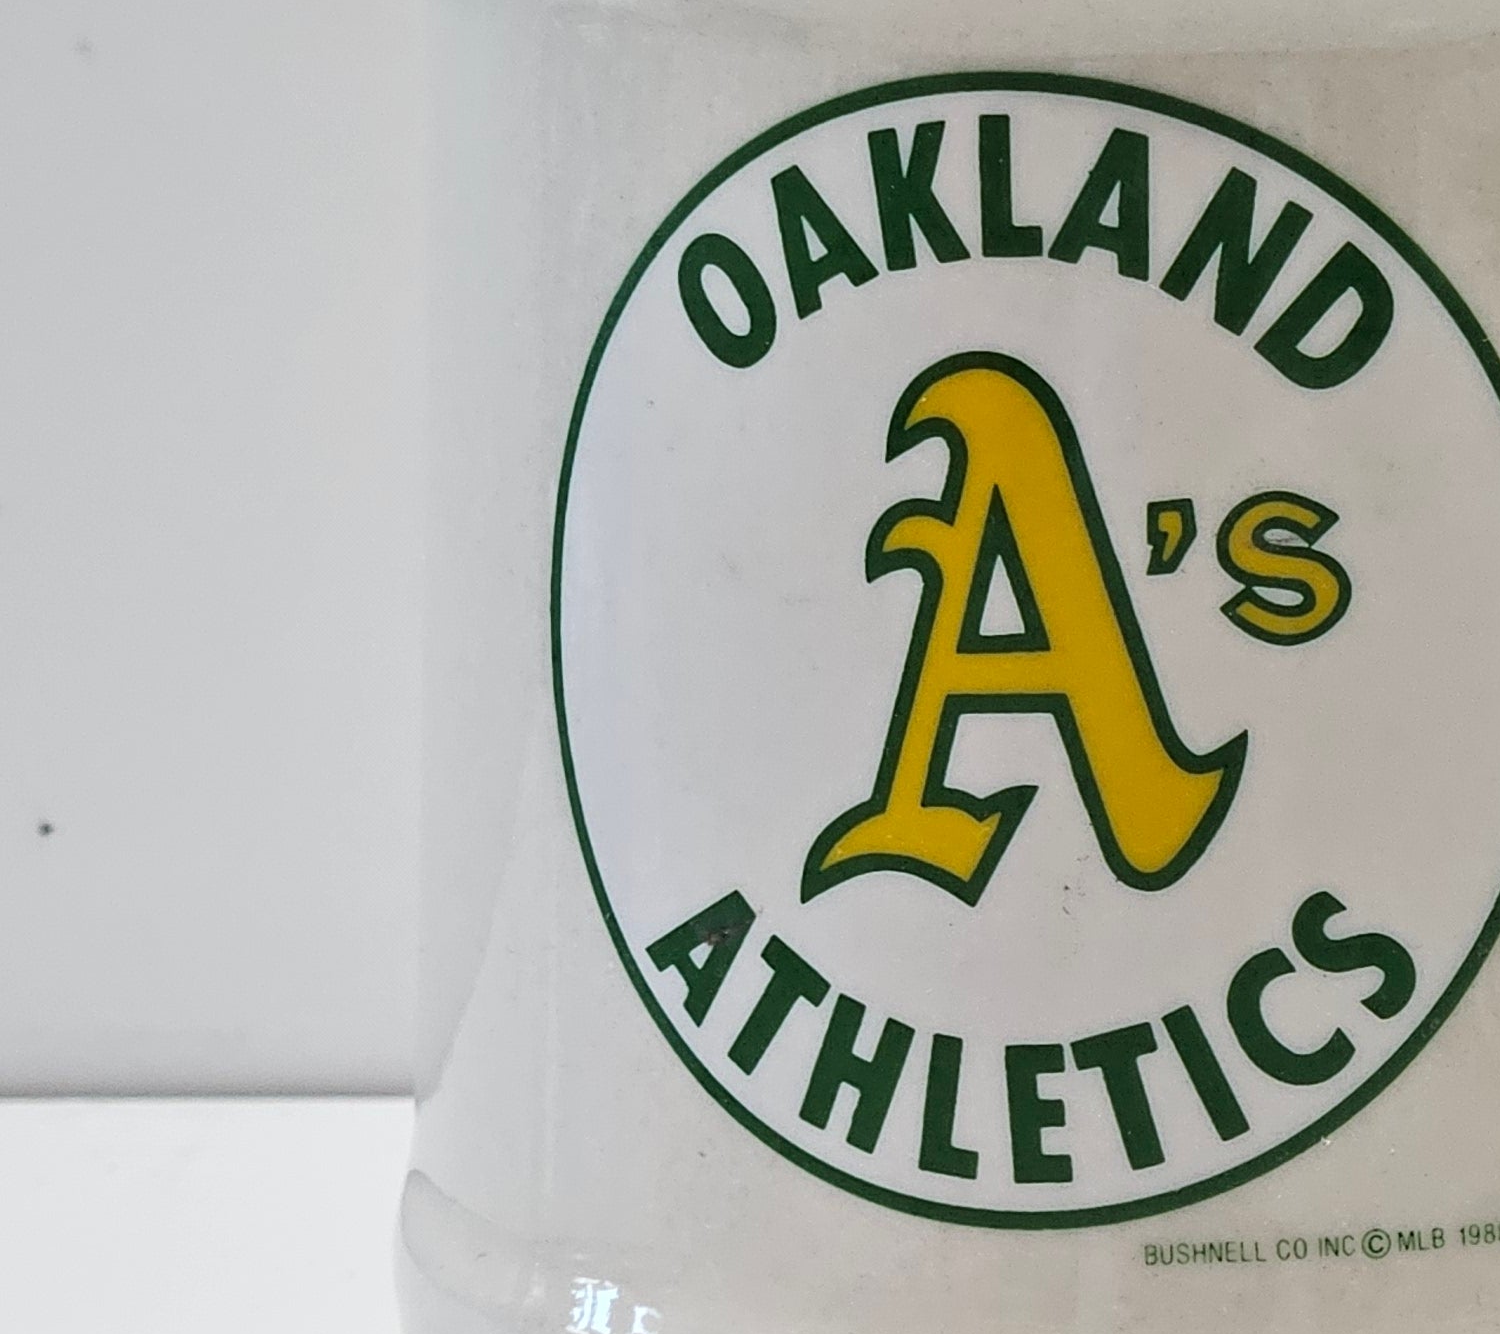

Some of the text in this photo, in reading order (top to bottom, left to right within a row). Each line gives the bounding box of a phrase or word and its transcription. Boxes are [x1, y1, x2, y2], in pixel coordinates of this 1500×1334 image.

[677, 113, 1395, 390] OAKLAND
[644, 889, 1418, 1185] ATHLETICS
[1143, 1239, 1267, 1267] BUSHNELL
[1276, 1237, 1308, 1262] CO
[1317, 1233, 1357, 1258] INC
